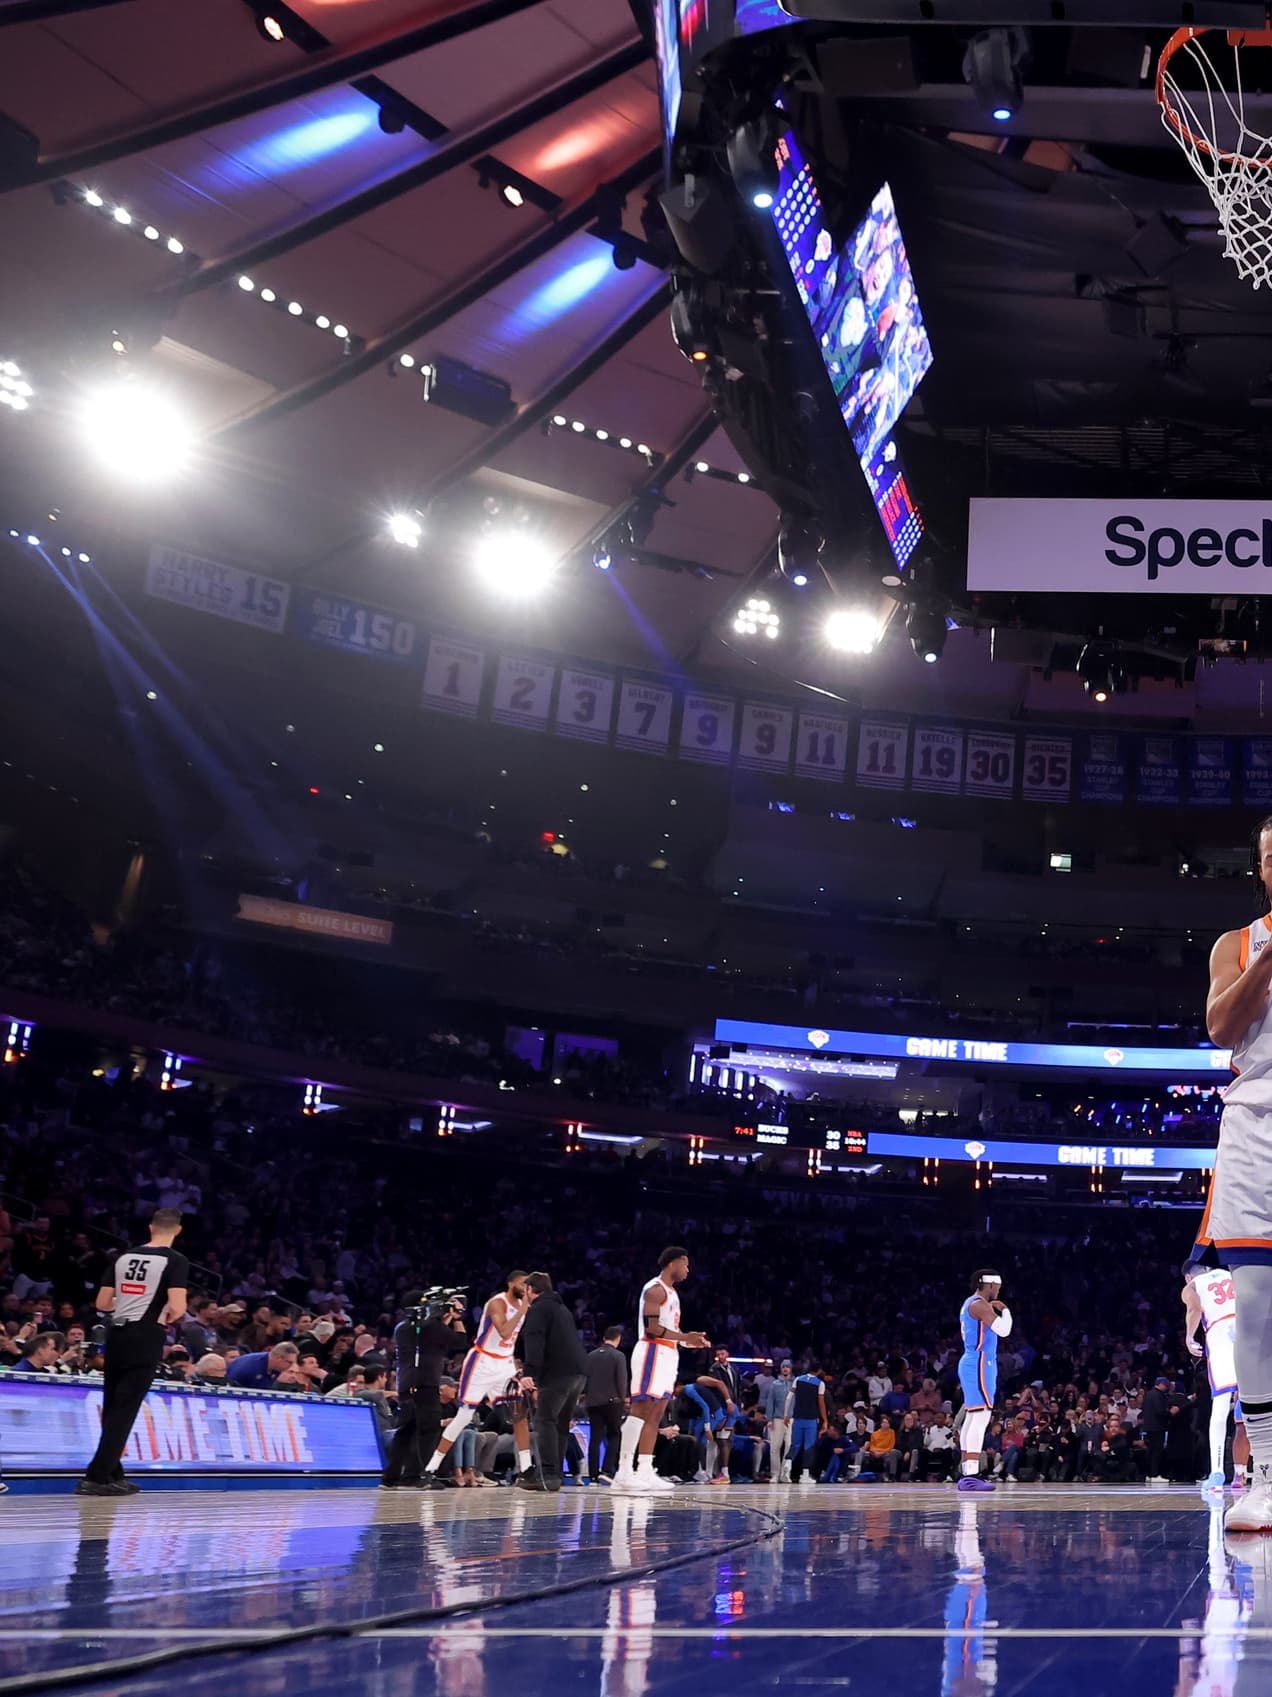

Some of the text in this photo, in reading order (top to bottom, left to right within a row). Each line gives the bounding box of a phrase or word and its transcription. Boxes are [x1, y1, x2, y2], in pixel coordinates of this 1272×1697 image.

[240, 575, 283, 617] 15
[349, 609, 416, 656] 150
[443, 661, 459, 696] 1
[510, 677, 536, 710] 2
[573, 690, 596, 723] 3
[635, 701, 656, 735] 7
[696, 714, 718, 746] 9
[755, 723, 776, 755] 9
[805, 731, 836, 765] 11
[866, 740, 896, 774] 11
[919, 745, 956, 779] 19
[970, 750, 1010, 784] 30
[1026, 755, 1068, 787] 35
[296, 911, 341, 931] SUITE
[343, 919, 386, 939] LEVEL
[906, 1036, 1009, 1061] GAME TIME
[735, 1127, 754, 1136] 7:41
[756, 1134, 787, 1145] MAGIC
[1058, 1145, 1155, 1166] GAME TIME
[125, 1259, 150, 1281] 35
[1208, 1279, 1236, 1304] 32
[218, 1398, 314, 1463] TIME
